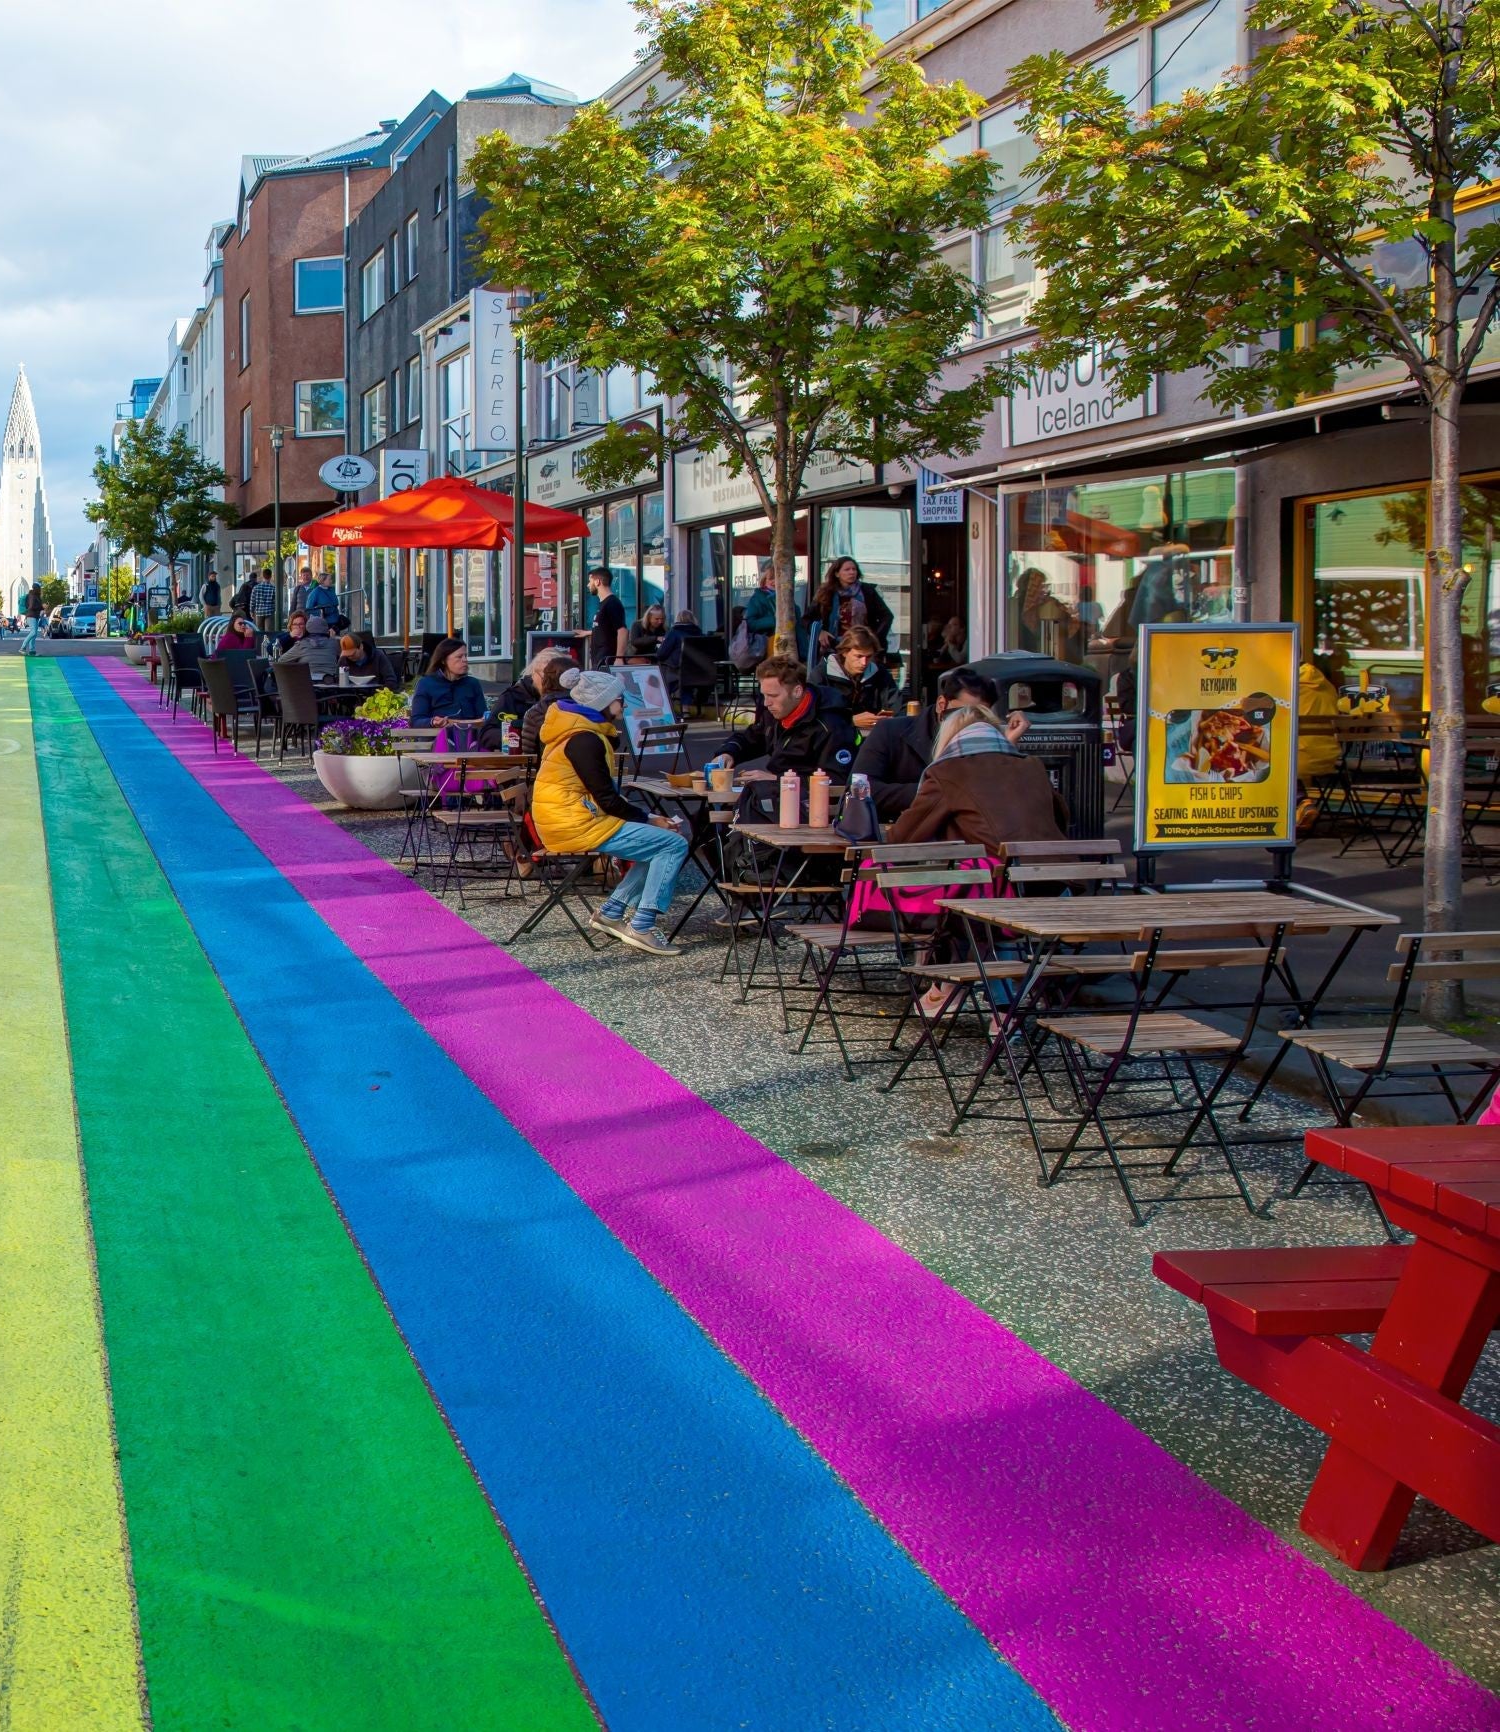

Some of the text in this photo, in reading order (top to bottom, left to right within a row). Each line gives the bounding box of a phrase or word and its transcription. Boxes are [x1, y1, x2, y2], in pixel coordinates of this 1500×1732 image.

[1036, 388, 1114, 435] Iceland
[693, 451, 722, 490] FISH
[713, 483, 757, 503] RESTAURA
[922, 496, 958, 505] TAX FREE
[922, 506, 958, 516] SHOPPING
[1190, 786, 1243, 800] FISH & CHIPS
[1154, 806, 1279, 820] SEATING AVAILABLE UPSTAIRS
[1164, 826, 1267, 836] 101ReykjavikStreetFood.is
